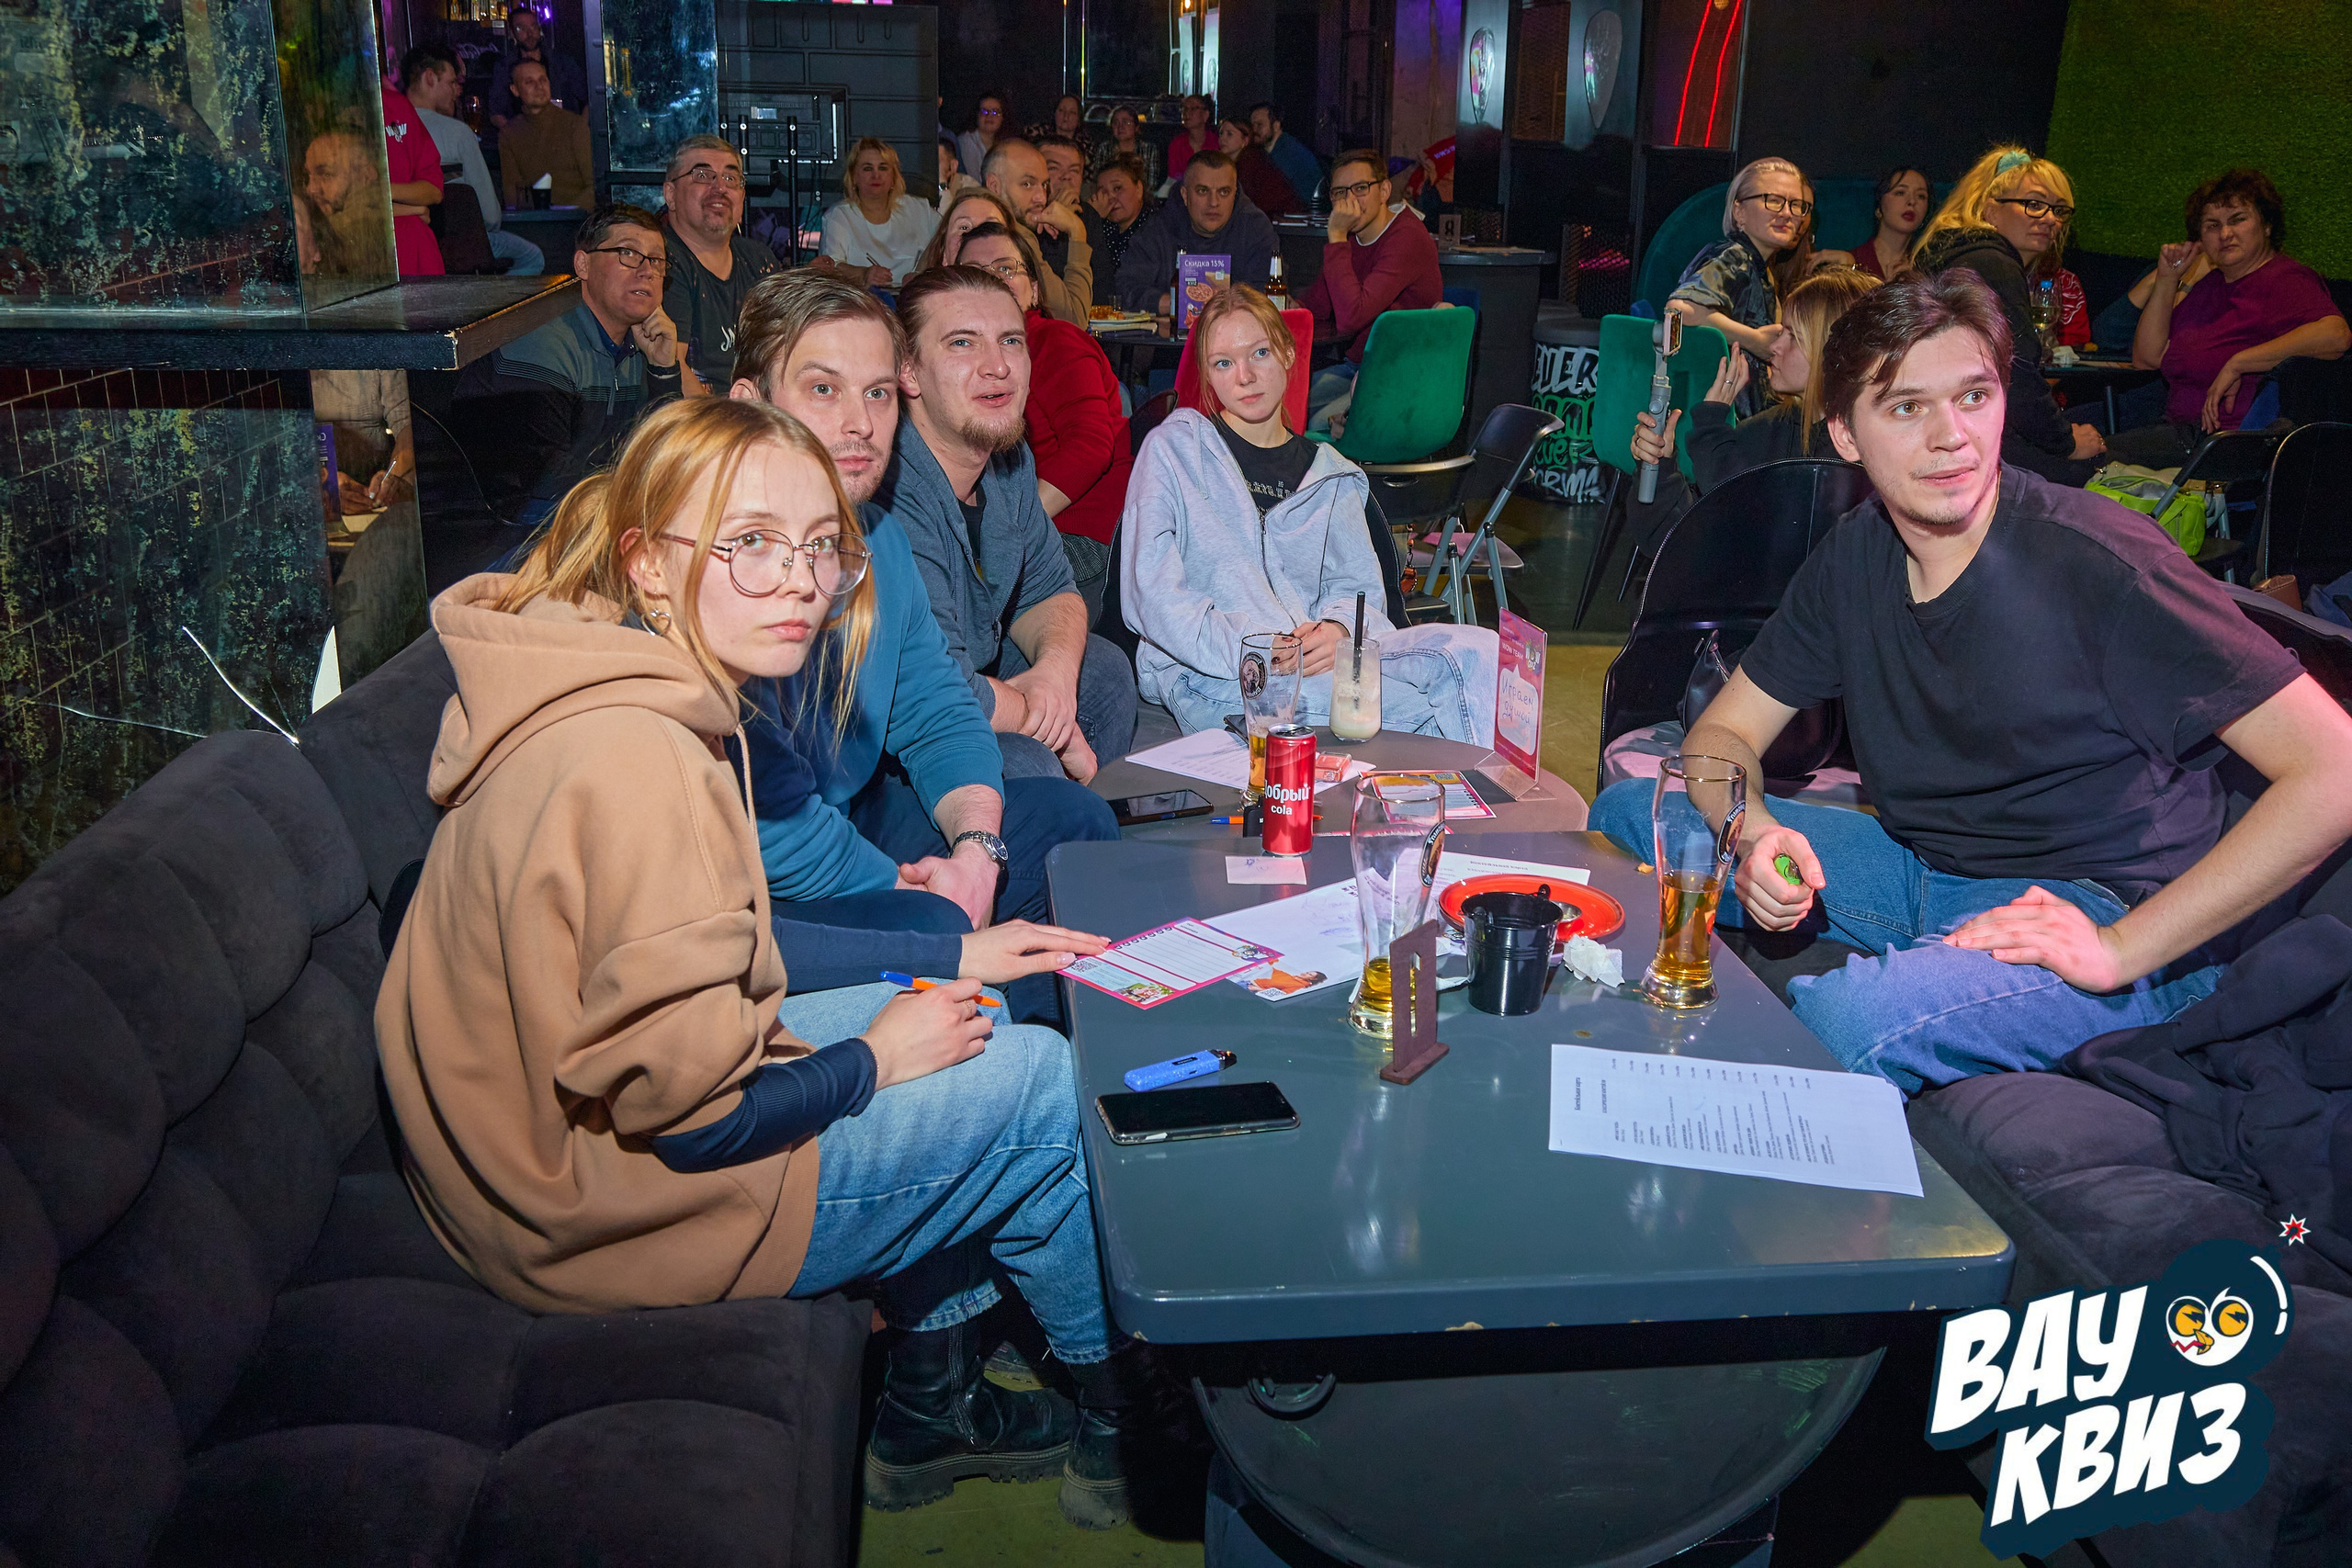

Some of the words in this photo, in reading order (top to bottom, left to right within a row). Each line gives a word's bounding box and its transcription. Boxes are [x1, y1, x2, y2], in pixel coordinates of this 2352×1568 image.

[1185, 259, 1210, 267] Скидка
[1211, 259, 1225, 267] 15%
[1502, 676, 1534, 710] Играем
[1271, 805, 1293, 815] cola
